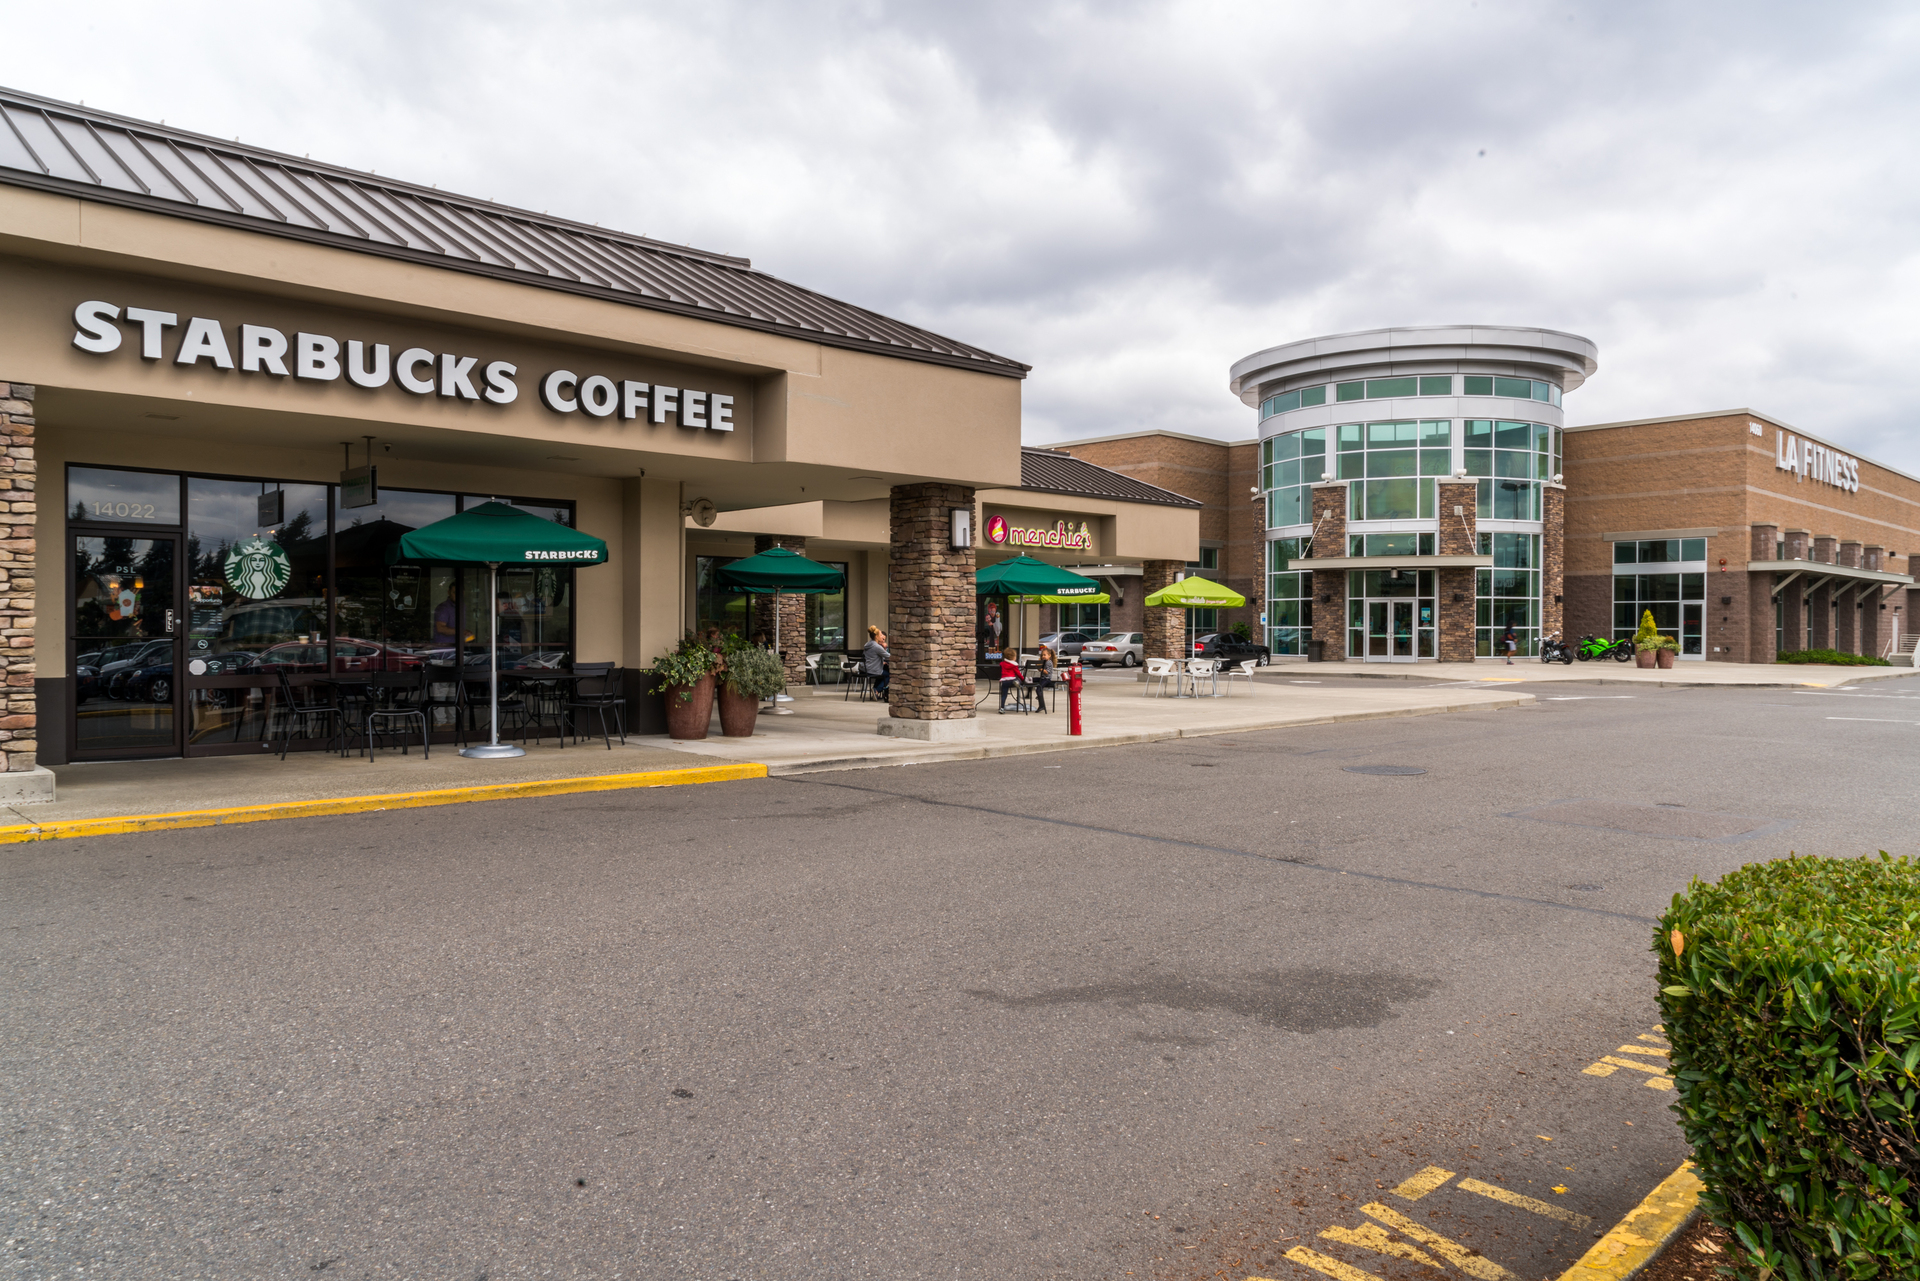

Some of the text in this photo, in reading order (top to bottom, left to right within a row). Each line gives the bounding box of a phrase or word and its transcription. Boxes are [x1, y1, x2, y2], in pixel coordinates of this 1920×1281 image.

[72, 299, 735, 433] STARBUCKS COFFEE
[1776, 431, 1859, 493] LA FITNESS
[91, 501, 156, 520] 14022
[1009, 519, 1093, 550] menchie's
[524, 548, 599, 561] STARBUCKS
[115, 565, 137, 574] PSL
[1056, 586, 1097, 596] STARBUCKS
